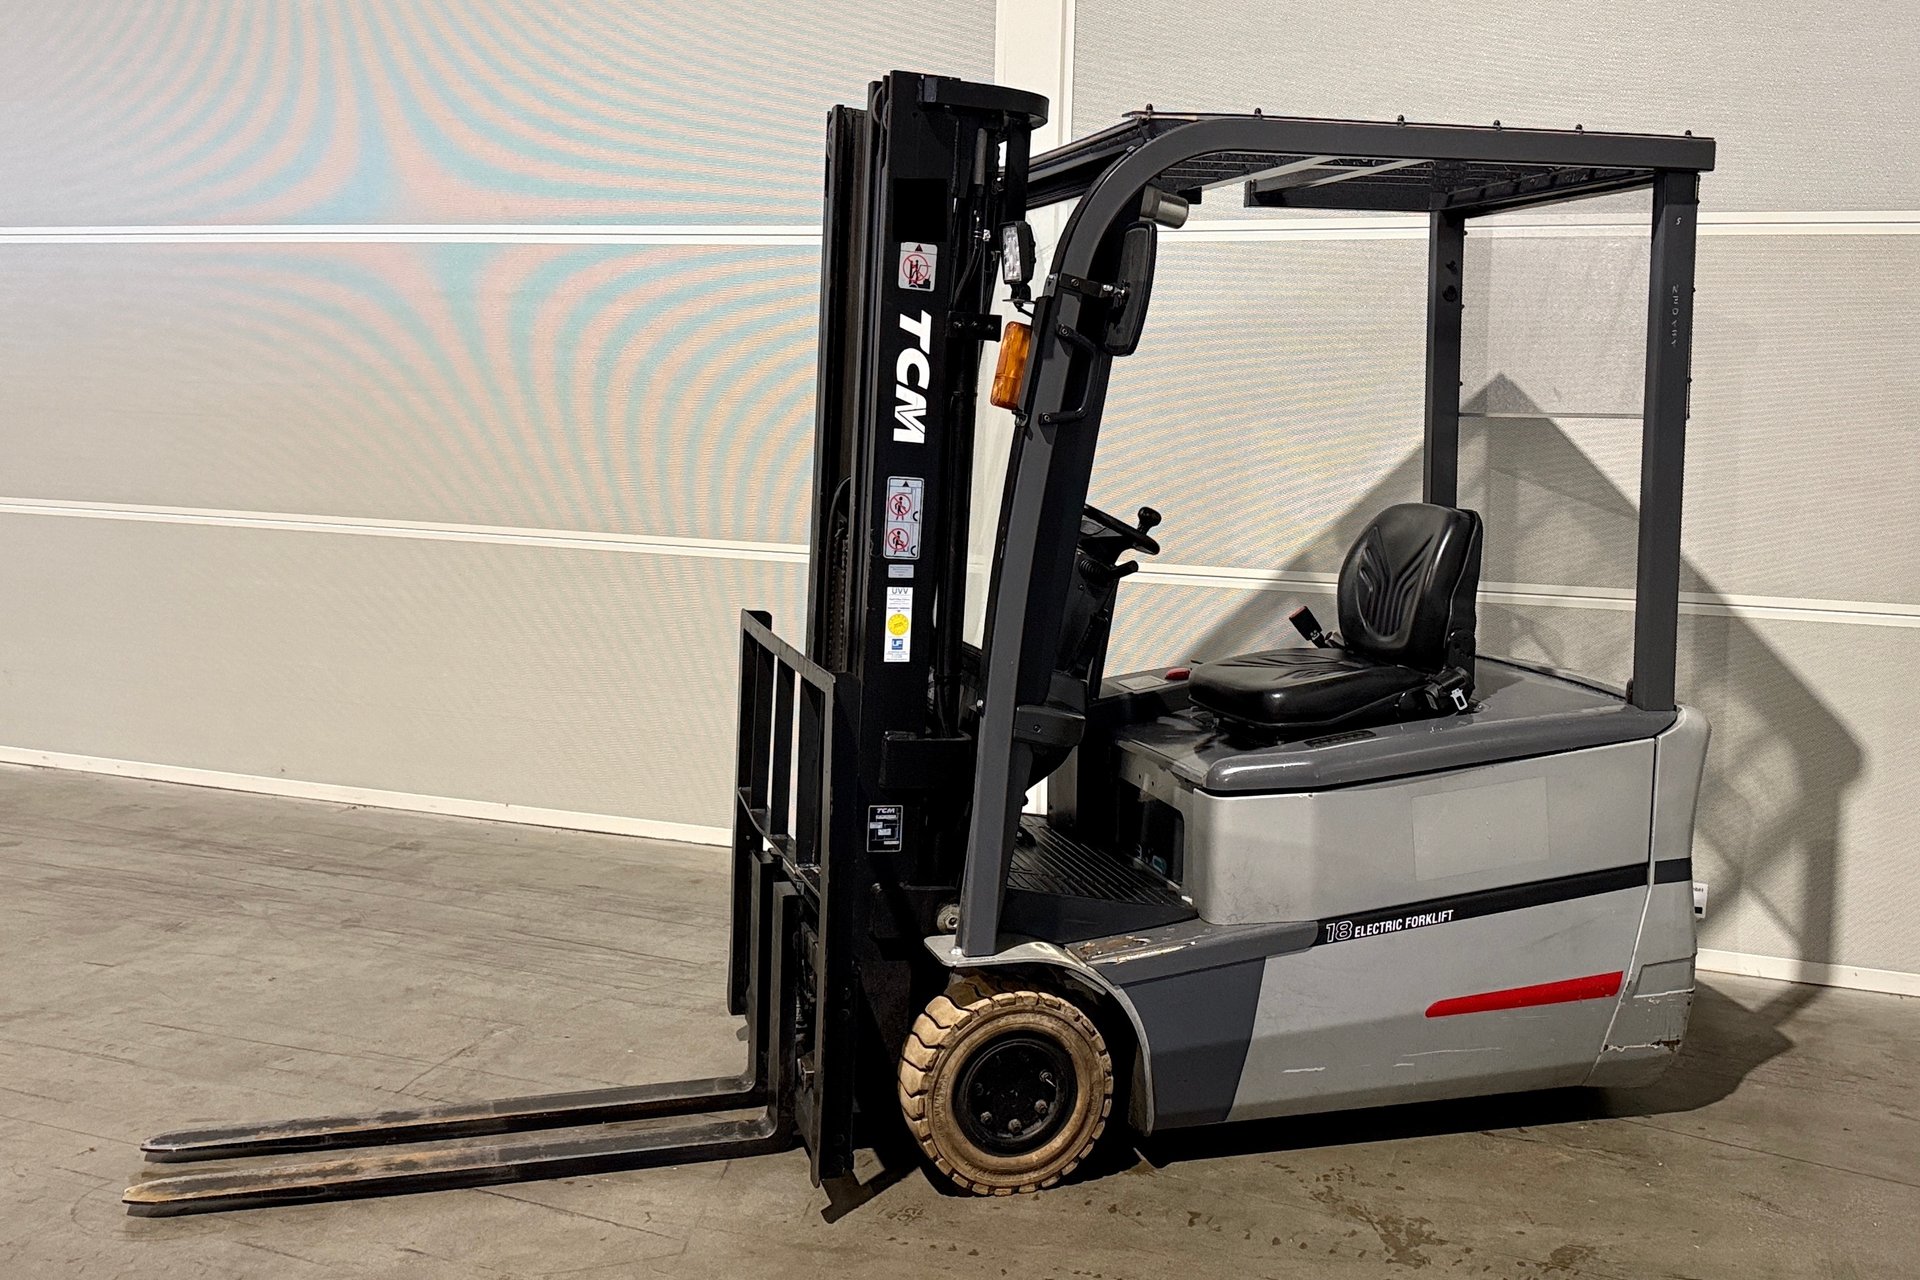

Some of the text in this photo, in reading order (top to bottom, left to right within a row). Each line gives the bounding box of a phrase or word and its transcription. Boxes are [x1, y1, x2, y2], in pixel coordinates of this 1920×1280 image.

[893, 310, 932, 444] TCM
[891, 587, 909, 595] UVV
[1325, 909, 1455, 943] 18 ELECTRIC FORKLIFT
